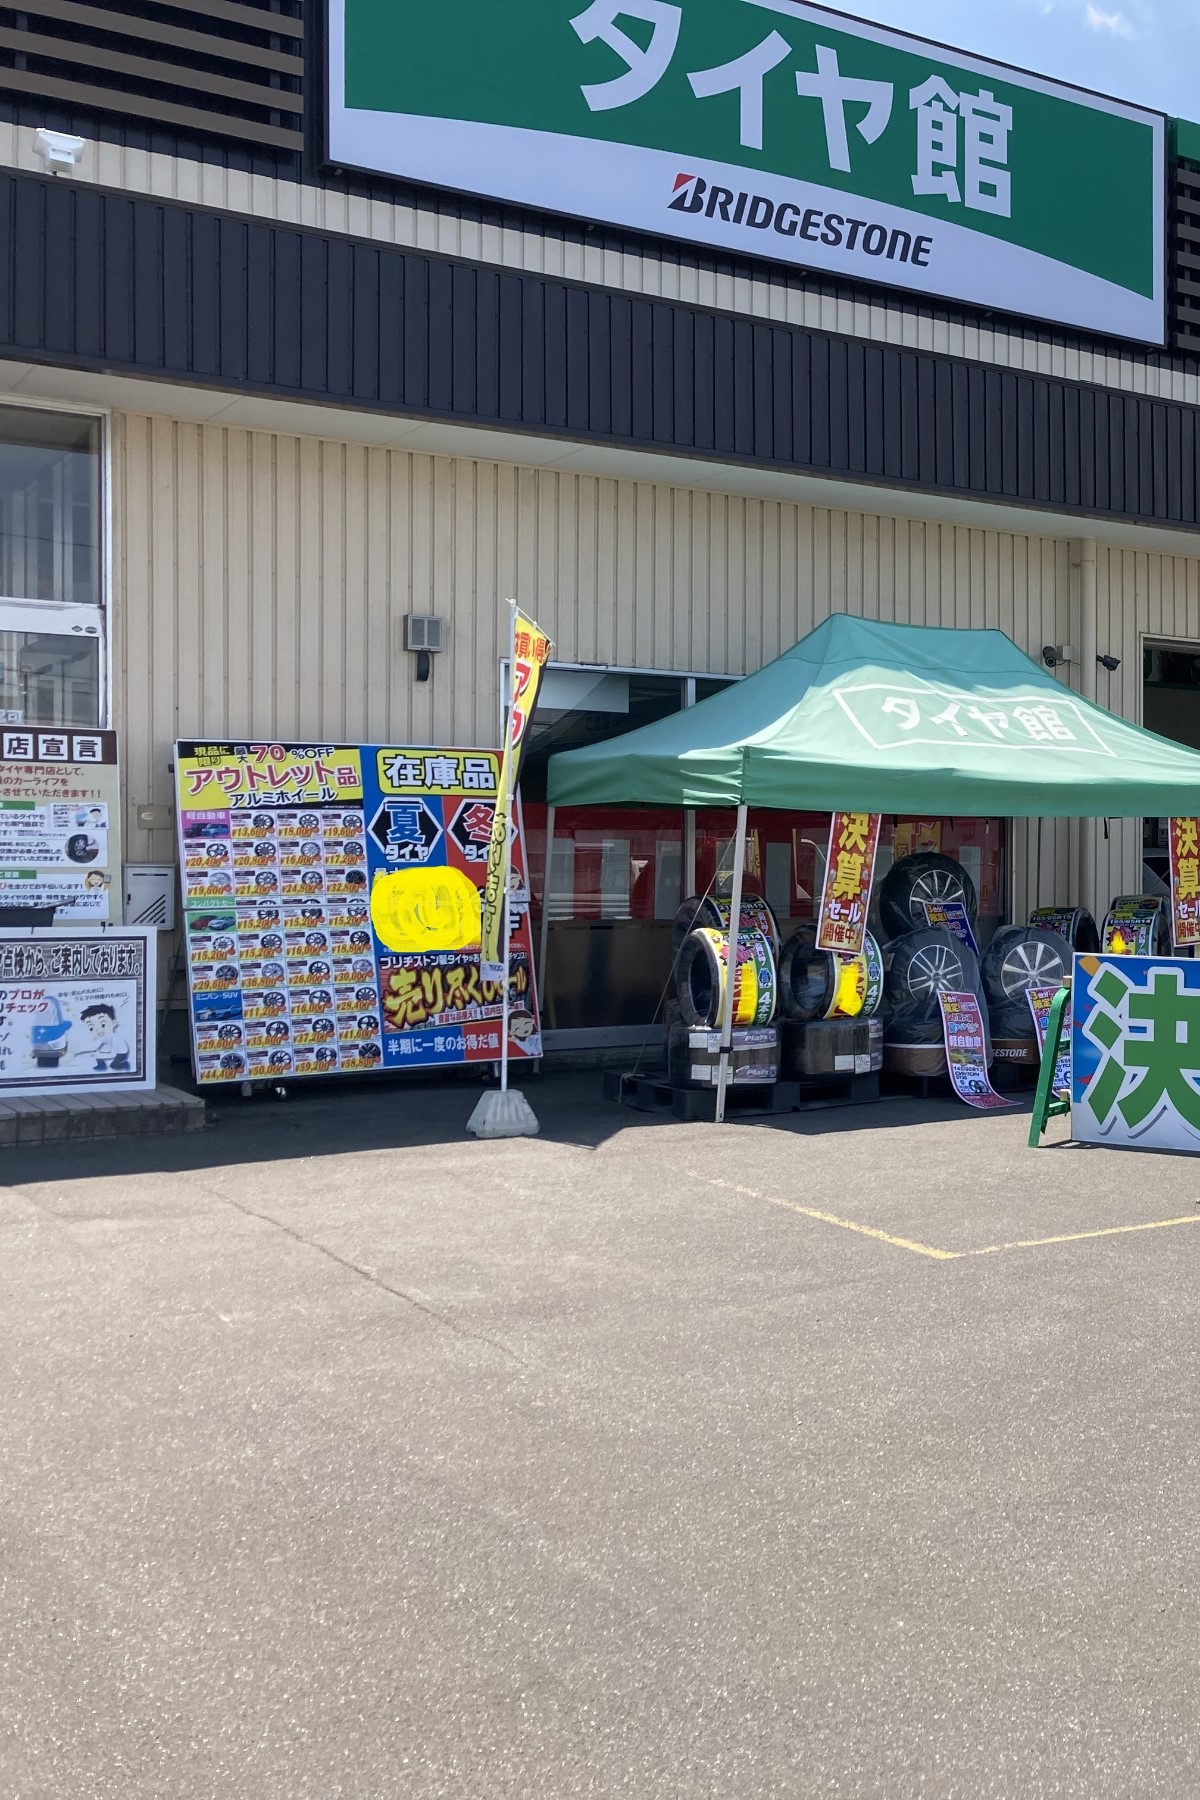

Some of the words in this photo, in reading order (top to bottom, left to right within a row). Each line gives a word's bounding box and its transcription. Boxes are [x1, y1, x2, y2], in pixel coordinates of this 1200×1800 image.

[570, 0, 1013, 219] タイヤ館
[667, 172, 933, 267] BRIDGESTONE
[881, 697, 1077, 741] タイヤ館
[194, 746, 230, 757] 現品に
[250, 745, 286, 763] 70
[291, 747, 335, 760] %OFF
[185, 760, 361, 794] アウトレット品
[383, 754, 496, 790] 在庫品
[0, 788, 101, 798] させていただきます!!
[230, 787, 338, 808] アルミホイール
[384, 802, 426, 844] 夏
[463, 803, 494, 843] 冬
[384, 845, 429, 861] タイヤ
[833, 813, 870, 900] 決算
[1176, 817, 1200, 900] 決算
[829, 899, 862, 924] セール
[0, 944, 141, 978] 点検から、ご案内しております。
[949, 1036, 982, 1047] 軽自動車
